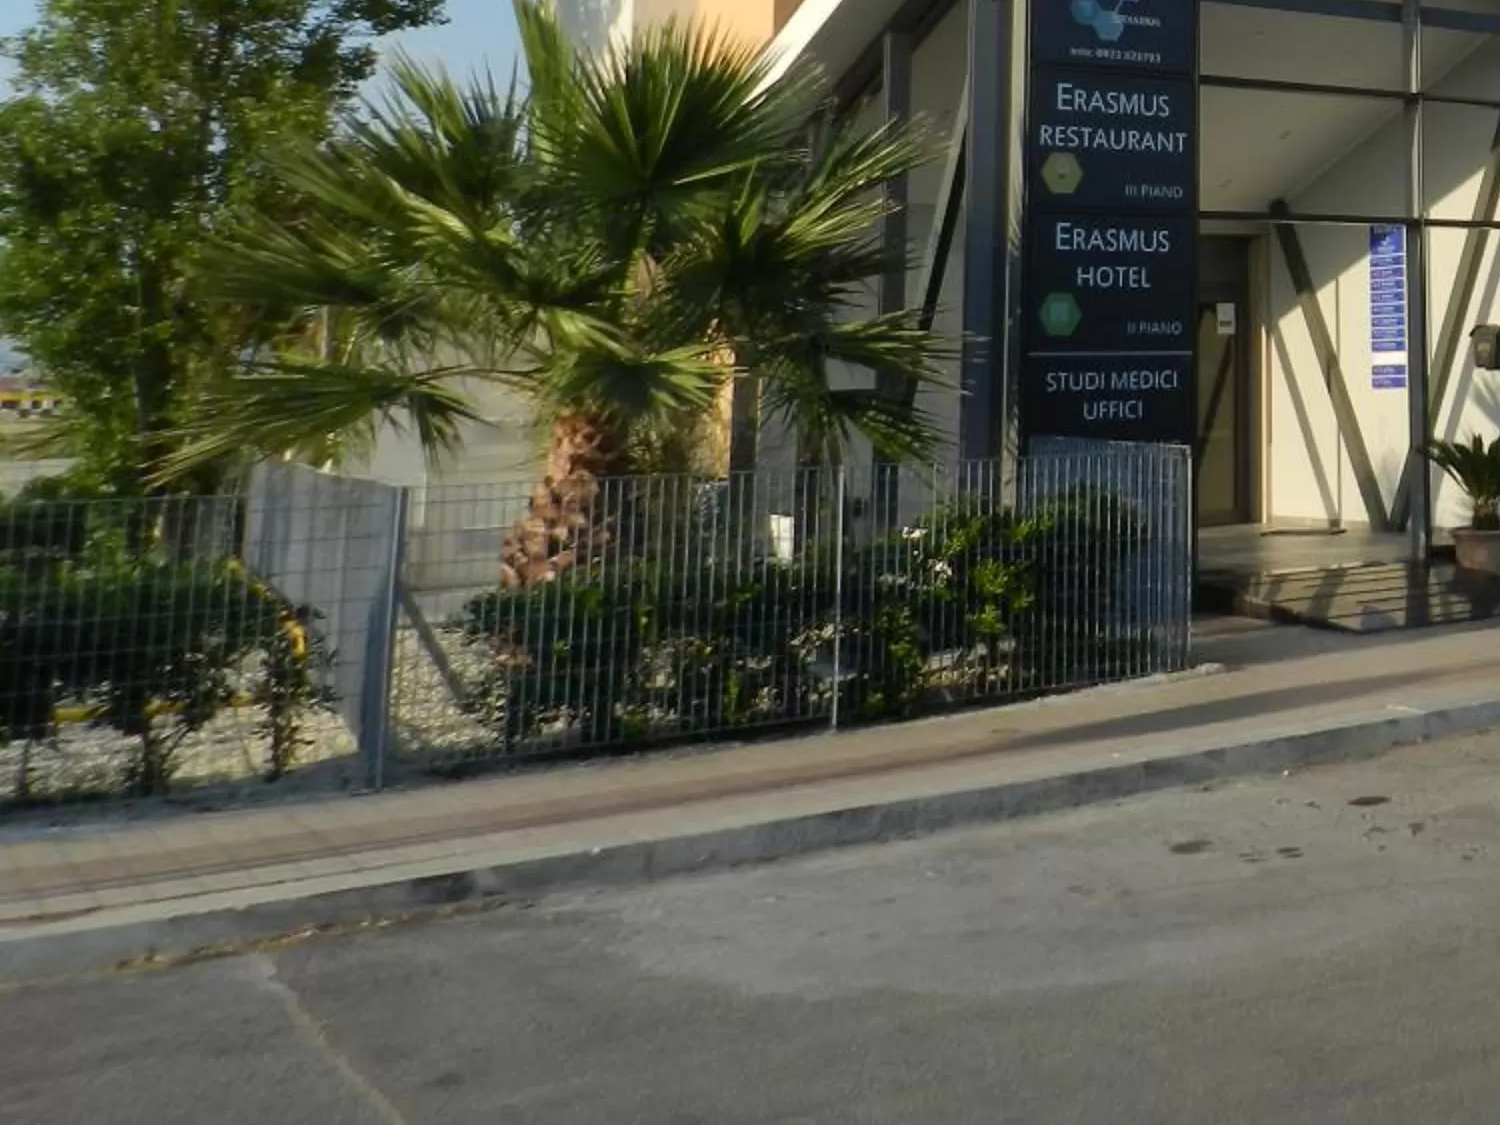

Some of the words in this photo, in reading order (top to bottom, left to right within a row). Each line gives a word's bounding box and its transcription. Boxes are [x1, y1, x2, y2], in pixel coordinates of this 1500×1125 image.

[1056, 82, 1170, 118] ERASMUS
[1039, 124, 1188, 154] RESTAURANT
[1141, 184, 1184, 199] PIANO
[1055, 221, 1170, 253] ERASMUS
[1076, 266, 1151, 289] HOTEL
[1138, 322, 1183, 336] PIANO
[1046, 372, 1106, 393] STUDI
[1110, 369, 1179, 391] MEDICI
[1083, 400, 1143, 421] UFFICI
